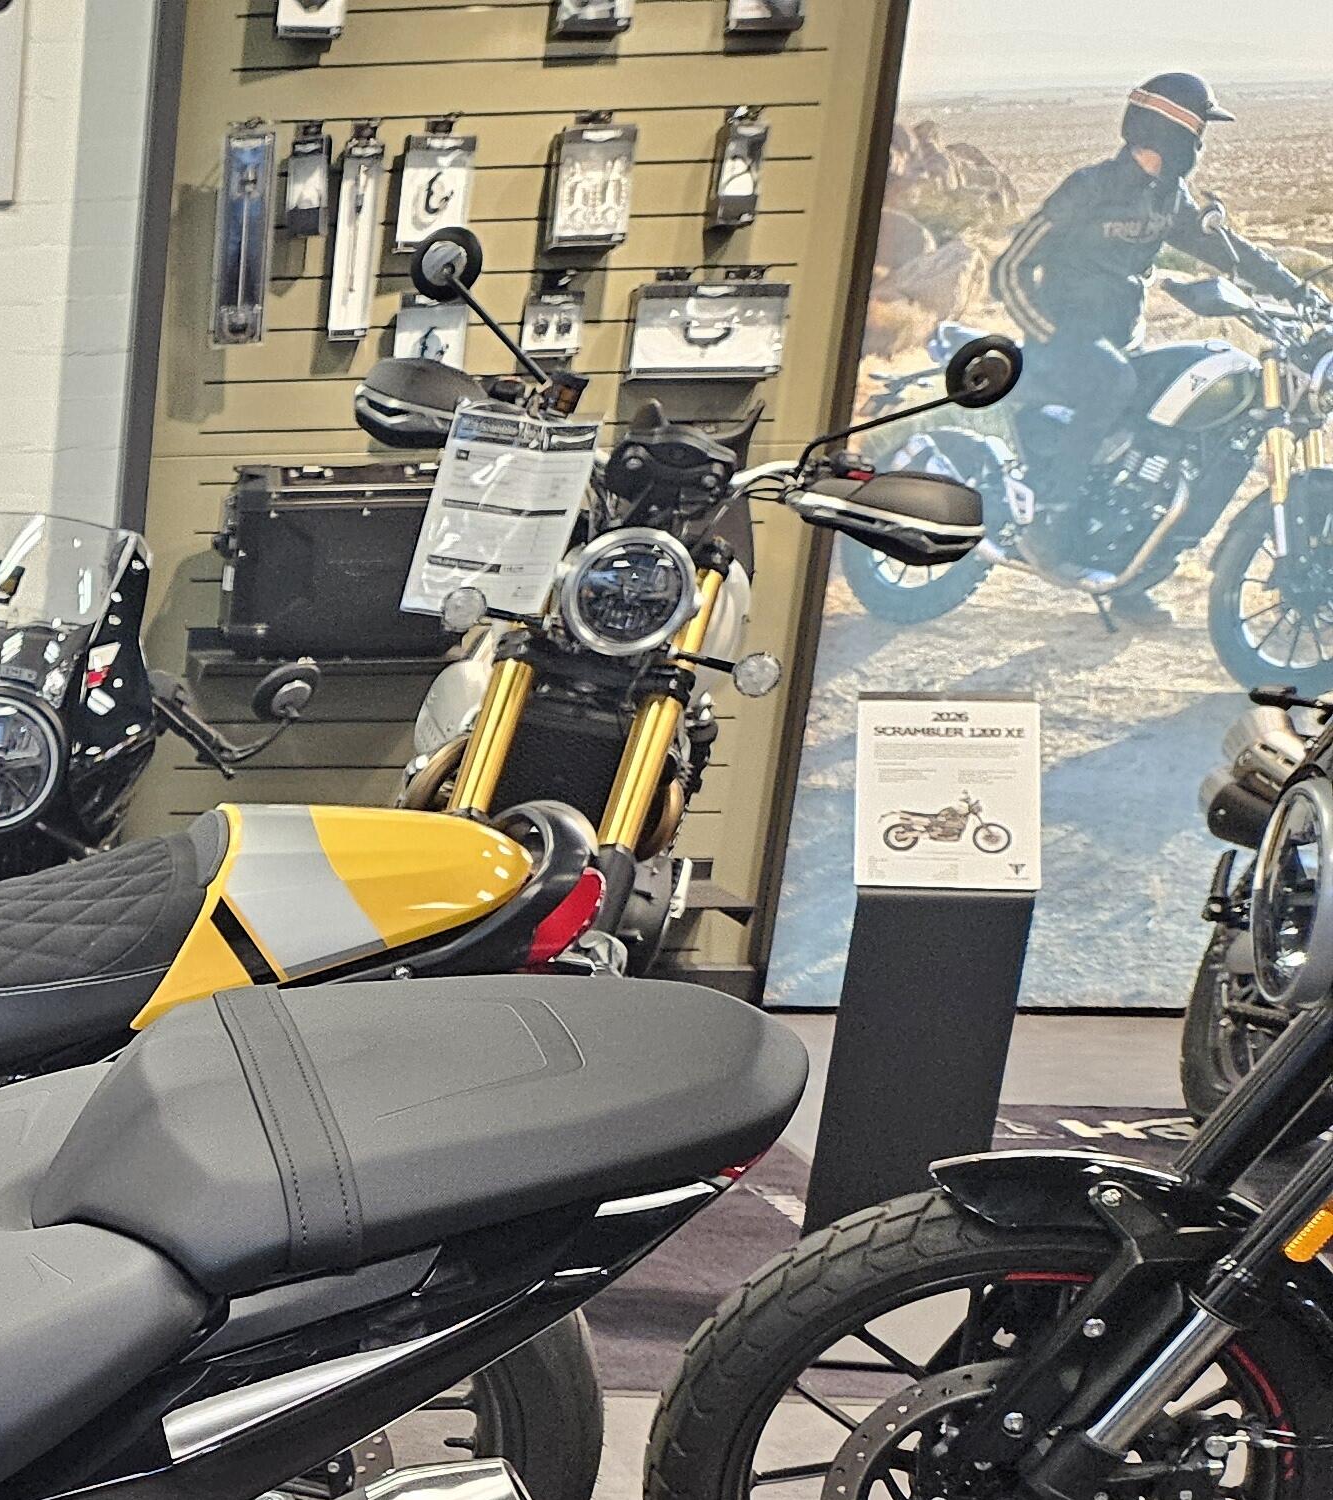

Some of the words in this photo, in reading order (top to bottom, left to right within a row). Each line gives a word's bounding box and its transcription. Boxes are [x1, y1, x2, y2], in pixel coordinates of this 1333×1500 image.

[932, 711, 969, 723] 2026
[873, 726, 964, 738] SCRAMBLER
[969, 727, 1001, 738] 1200
